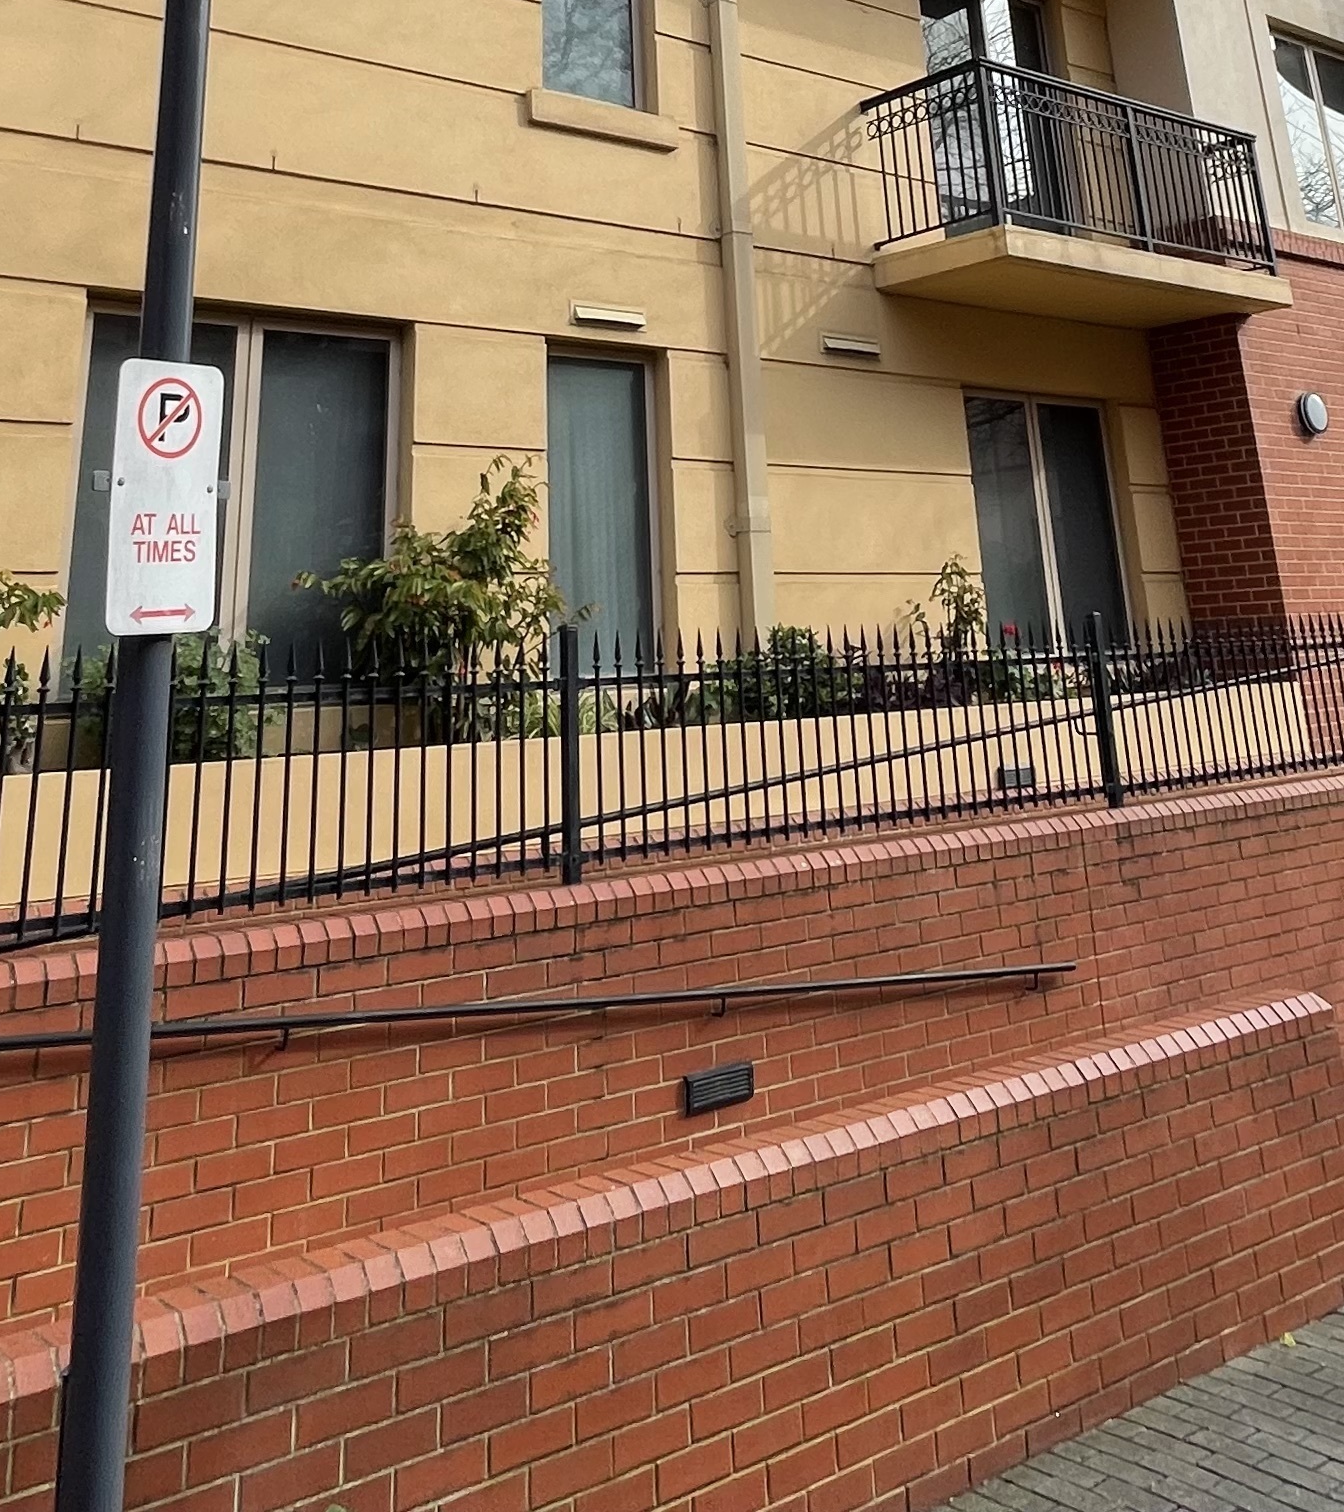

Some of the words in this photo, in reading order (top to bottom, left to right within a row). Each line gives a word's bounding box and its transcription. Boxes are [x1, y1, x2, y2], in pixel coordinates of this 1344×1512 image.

[158, 392, 190, 442] P
[130, 513, 158, 536] AT
[166, 513, 202, 535] ALL
[132, 539, 197, 564] TIMES
